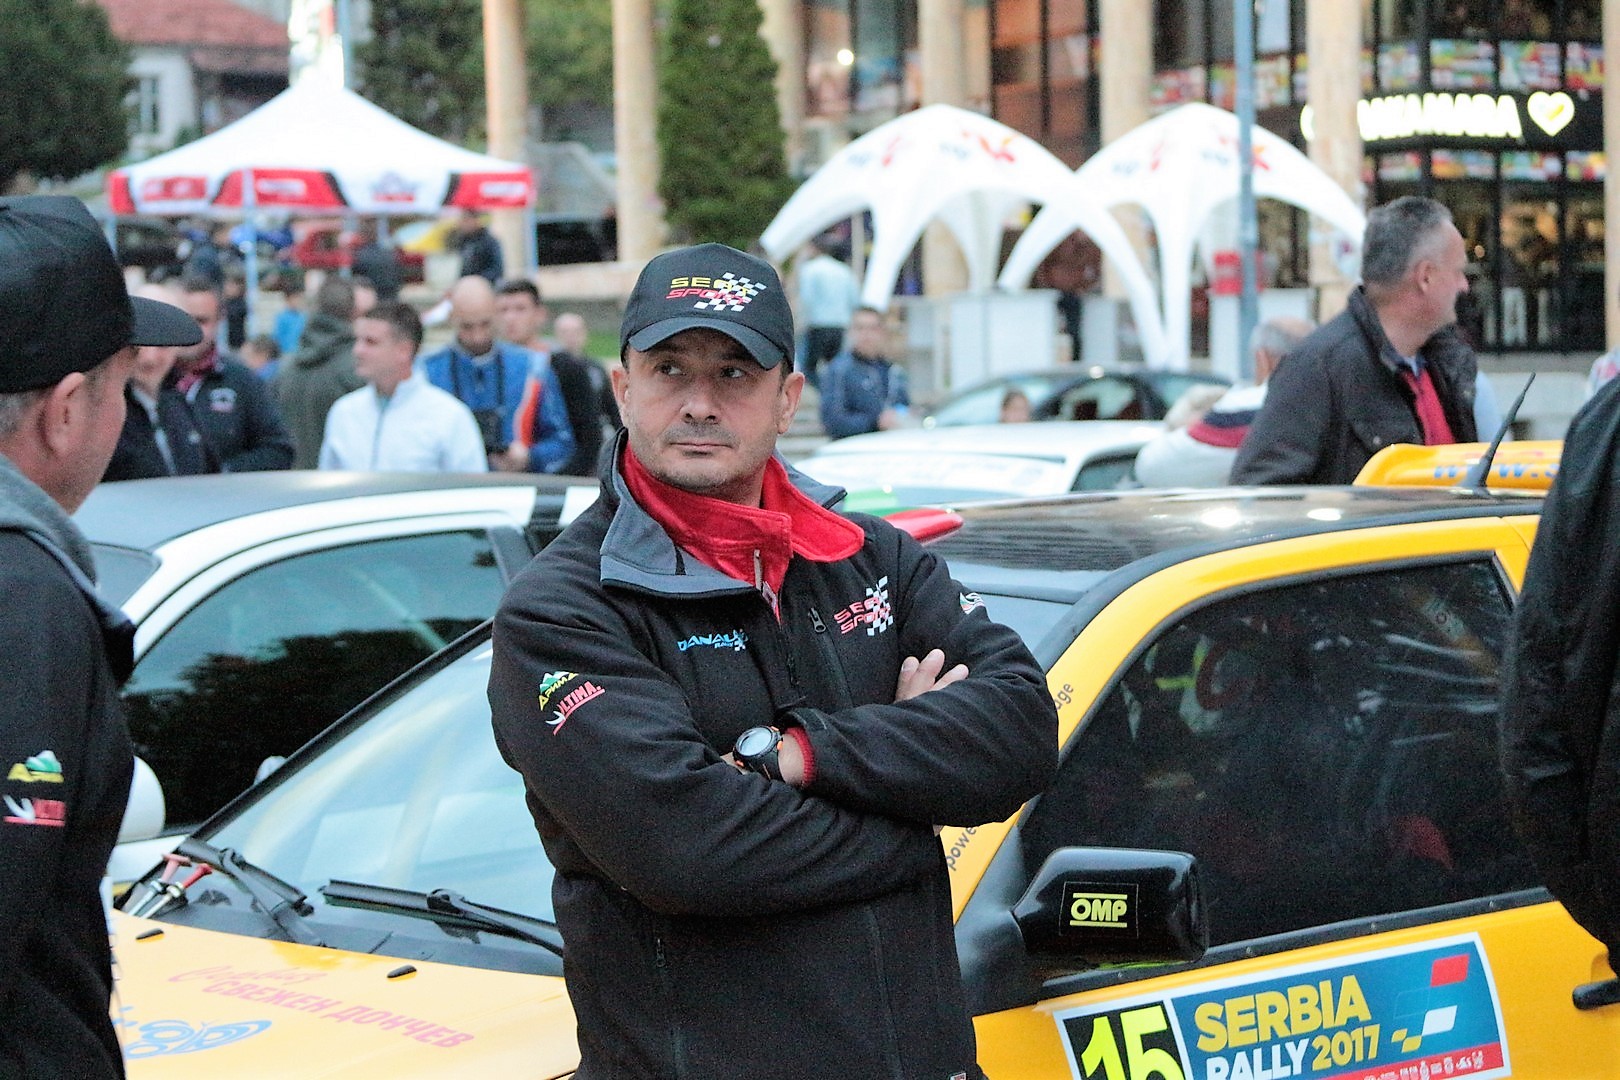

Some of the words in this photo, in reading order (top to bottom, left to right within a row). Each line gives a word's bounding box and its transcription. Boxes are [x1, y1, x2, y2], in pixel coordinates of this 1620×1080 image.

[946, 827, 977, 871] powe
[1070, 898, 1127, 922] OMP
[201, 979, 343, 1014] СВЕЖЕН
[318, 1004, 476, 1049] ДОНЧЕВ
[1080, 1004, 1187, 1080] 15
[1194, 974, 1373, 1053] SERBIA
[1206, 1038, 1310, 1080] RALLY
[1311, 1023, 1381, 1072] 2017
